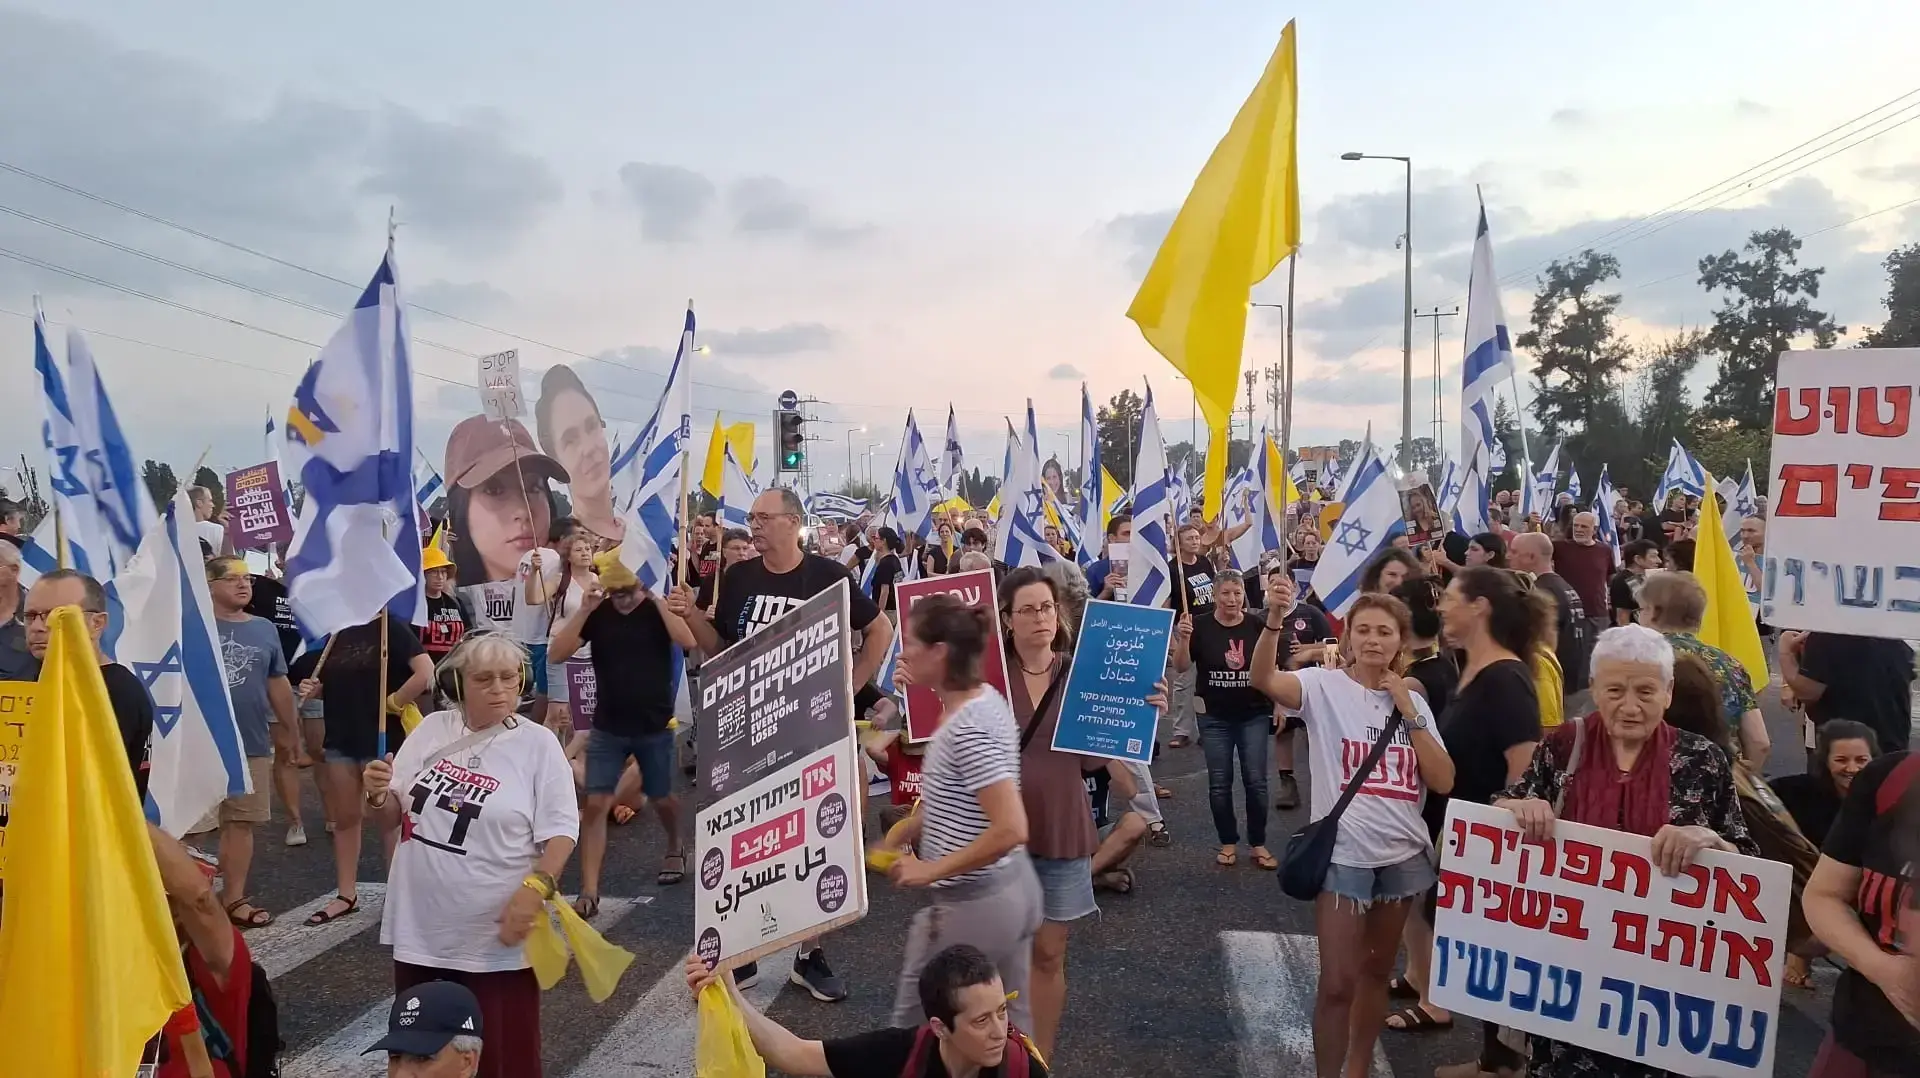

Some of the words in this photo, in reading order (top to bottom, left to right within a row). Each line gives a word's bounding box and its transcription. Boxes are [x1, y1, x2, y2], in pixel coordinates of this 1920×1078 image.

[483, 351, 515, 370] STOP
[485, 374, 516, 388] WAR
[237, 492, 271, 505] מצילים
[244, 514, 276, 529] חיים
[750, 612, 840, 681] במלחמה
[1104, 651, 1140, 670] بضمان
[750, 639, 839, 708] מפסידים
[1100, 667, 1136, 685] متبادل
[1209, 671, 1236, 680] כרכור
[703, 665, 746, 710] כולם
[1079, 691, 1099, 702] מקור
[1101, 694, 1124, 704] מאותו
[751, 708, 762, 724] IN
[763, 696, 786, 717] WAR
[1092, 705, 1126, 716] מחוייבים
[1126, 697, 1145, 706] כולנו
[718, 704, 746, 724] לכיבוש
[751, 699, 799, 733] EVERYONE
[1077, 714, 1103, 725] הדדית
[1104, 718, 1136, 729] לערבות
[718, 716, 746, 739] בעיניים
[751, 723, 778, 747] LOSES
[474, 776, 499, 791] הורי
[804, 763, 833, 797] אין
[750, 777, 800, 823] פיתרון
[409, 783, 483, 846] די
[706, 803, 746, 836] צבאי
[784, 813, 798, 839] لا
[738, 828, 780, 859] يوجد
[795, 845, 827, 882] حل
[715, 863, 787, 922] عسكري
[1436, 935, 1583, 1022] עכשיו
[1597, 976, 1769, 1069] עסקה
